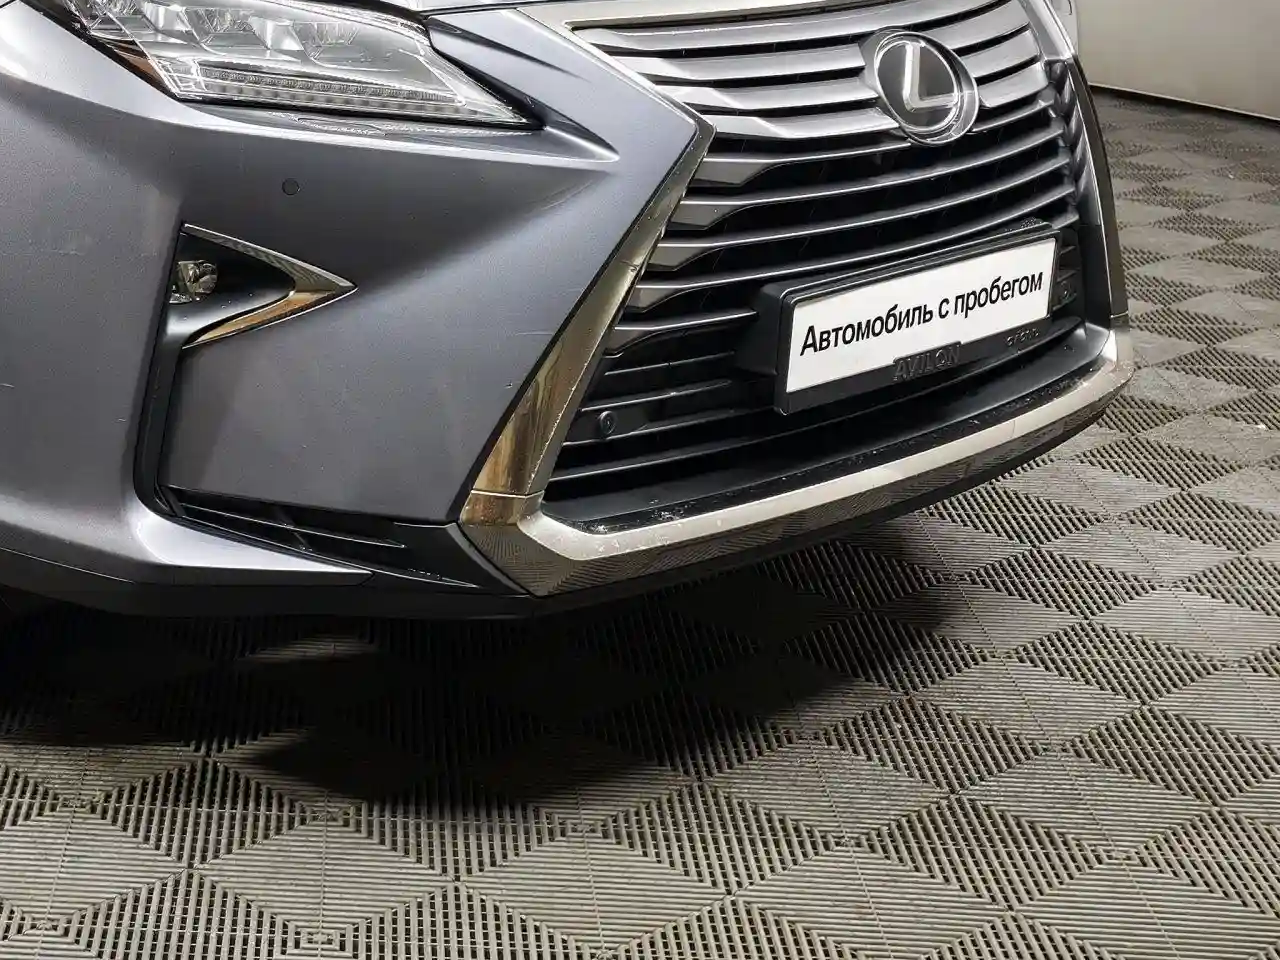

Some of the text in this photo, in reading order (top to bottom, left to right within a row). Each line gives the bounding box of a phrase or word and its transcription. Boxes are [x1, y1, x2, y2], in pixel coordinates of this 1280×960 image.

[800, 272, 1043, 357] Автомобиль с пробегом
[893, 344, 961, 381] AVILON
